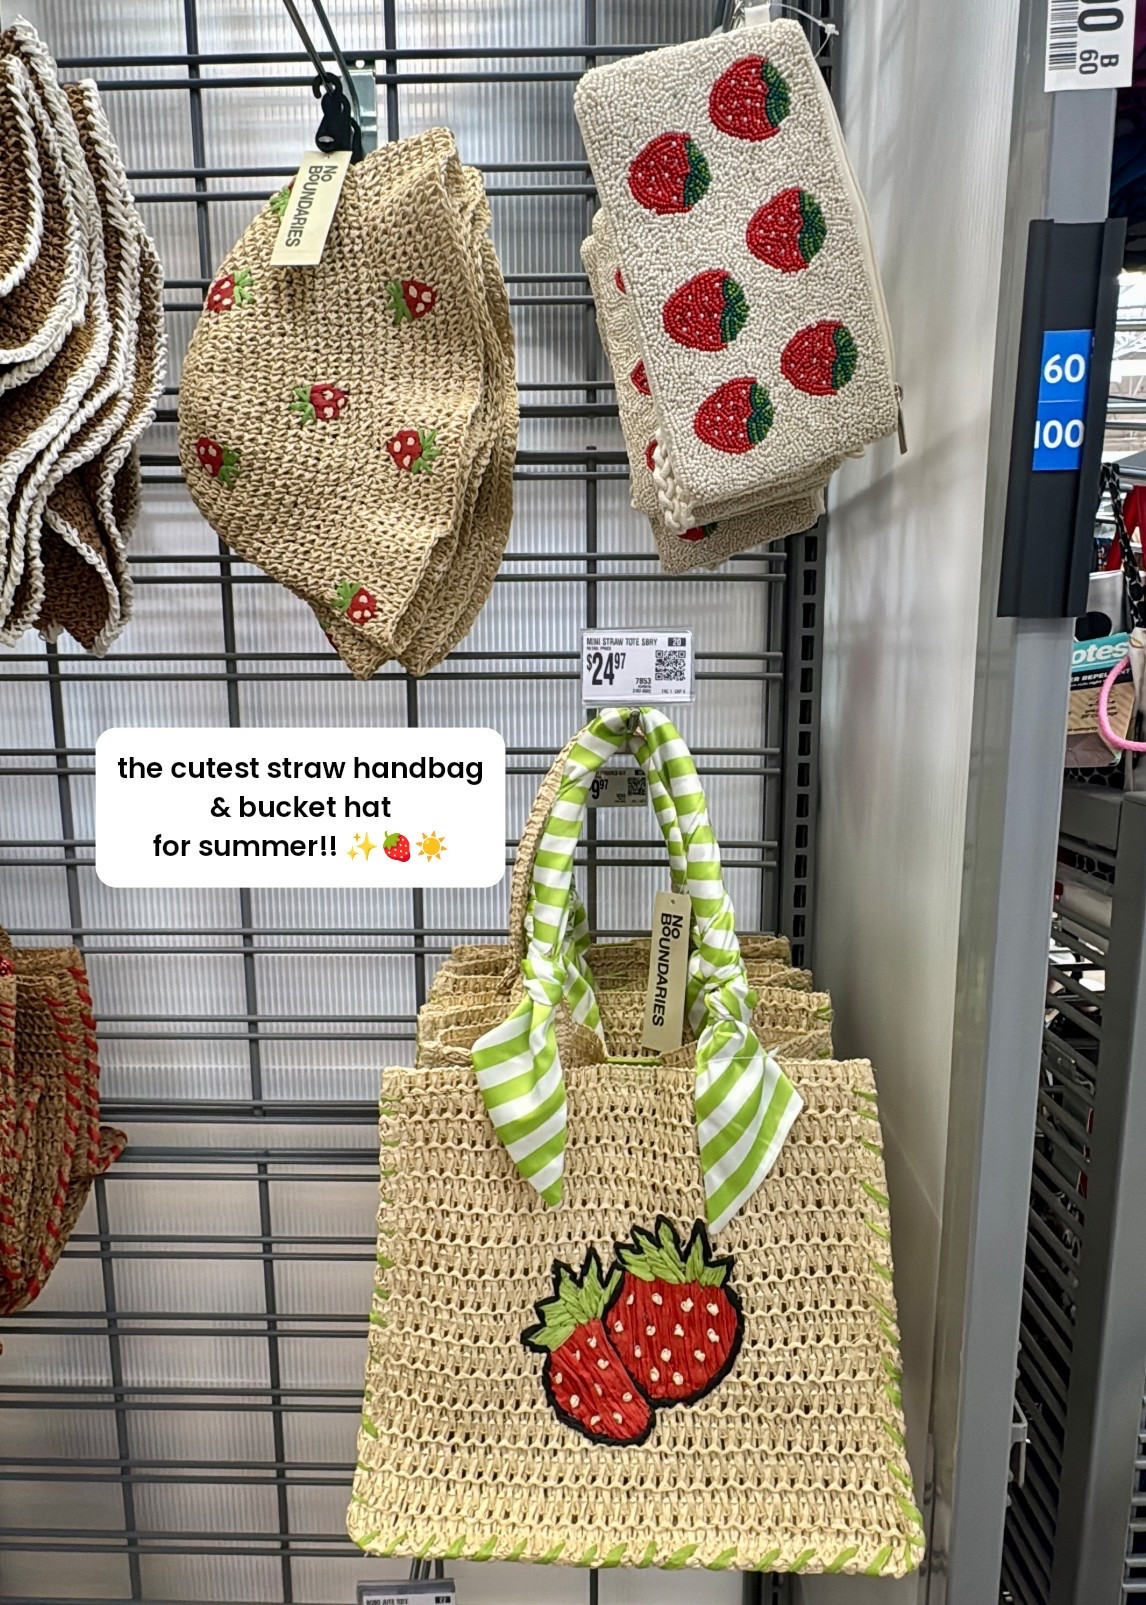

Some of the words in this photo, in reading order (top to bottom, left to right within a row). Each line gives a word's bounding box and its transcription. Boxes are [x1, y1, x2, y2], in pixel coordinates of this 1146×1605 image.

[1078, 0, 1124, 32] 0
[1079, 49, 1099, 75] 60
[1100, 54, 1119, 68] B
[285, 165, 323, 247] BOUNDARIES
[1043, 353, 1086, 384] 60
[1034, 419, 1085, 449] 100
[586, 638, 600, 646] MINI
[603, 638, 624, 646] STRAW
[626, 638, 640, 646] TOTE
[642, 638, 658, 646] SBRY
[1072, 641, 1129, 664] otes
[652, 912, 672, 1027] BOUNDARIES
